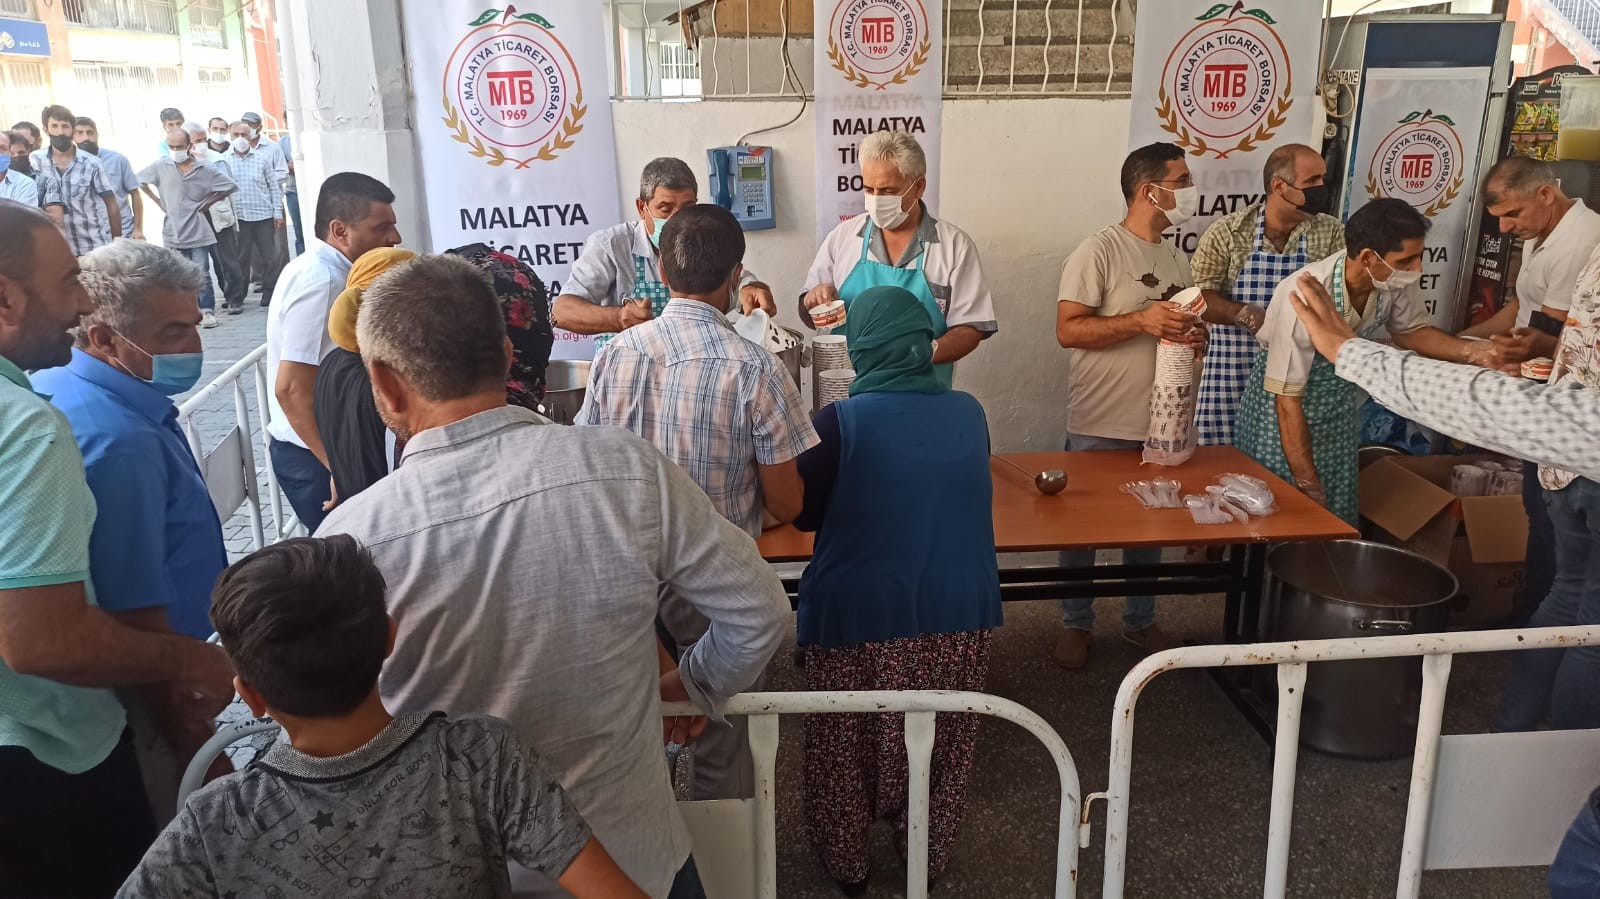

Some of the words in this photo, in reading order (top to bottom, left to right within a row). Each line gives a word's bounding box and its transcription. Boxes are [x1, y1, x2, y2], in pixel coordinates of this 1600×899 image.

[844, 0, 868, 39] MALATYA
[899, 13, 914, 56] BORSASI
[862, 17, 894, 43] MTB
[494, 39, 548, 65] TİCARET
[868, 46, 888, 54] 1969
[1216, 33, 1264, 59] TİCARET
[464, 47, 494, 100] MALATYA
[1181, 41, 1214, 91] MALATYA
[486, 70, 535, 106] MTB
[543, 65, 560, 123] BORSASI
[1203, 64, 1248, 98] MTB
[1250, 59, 1271, 116] BORSASI
[470, 102, 485, 126] T.C.
[499, 109, 528, 120] 1969
[1183, 94, 1196, 117] T.C.
[1211, 101, 1237, 112] 1969
[832, 116, 926, 135] MALATYA
[1384, 137, 1411, 174] MALATYA
[1412, 132, 1447, 150] TİCARET
[1434, 151, 1450, 191] BORSASI
[1401, 154, 1434, 178] MTB
[1406, 180, 1425, 188] 1969
[460, 203, 589, 230] MALATYA
[357, 789, 382, 814] ONLY
[384, 773, 405, 792] FOR
[406, 752, 432, 775] BOYS
[271, 864, 293, 881] FOR
[292, 878, 320, 896] BOYS
